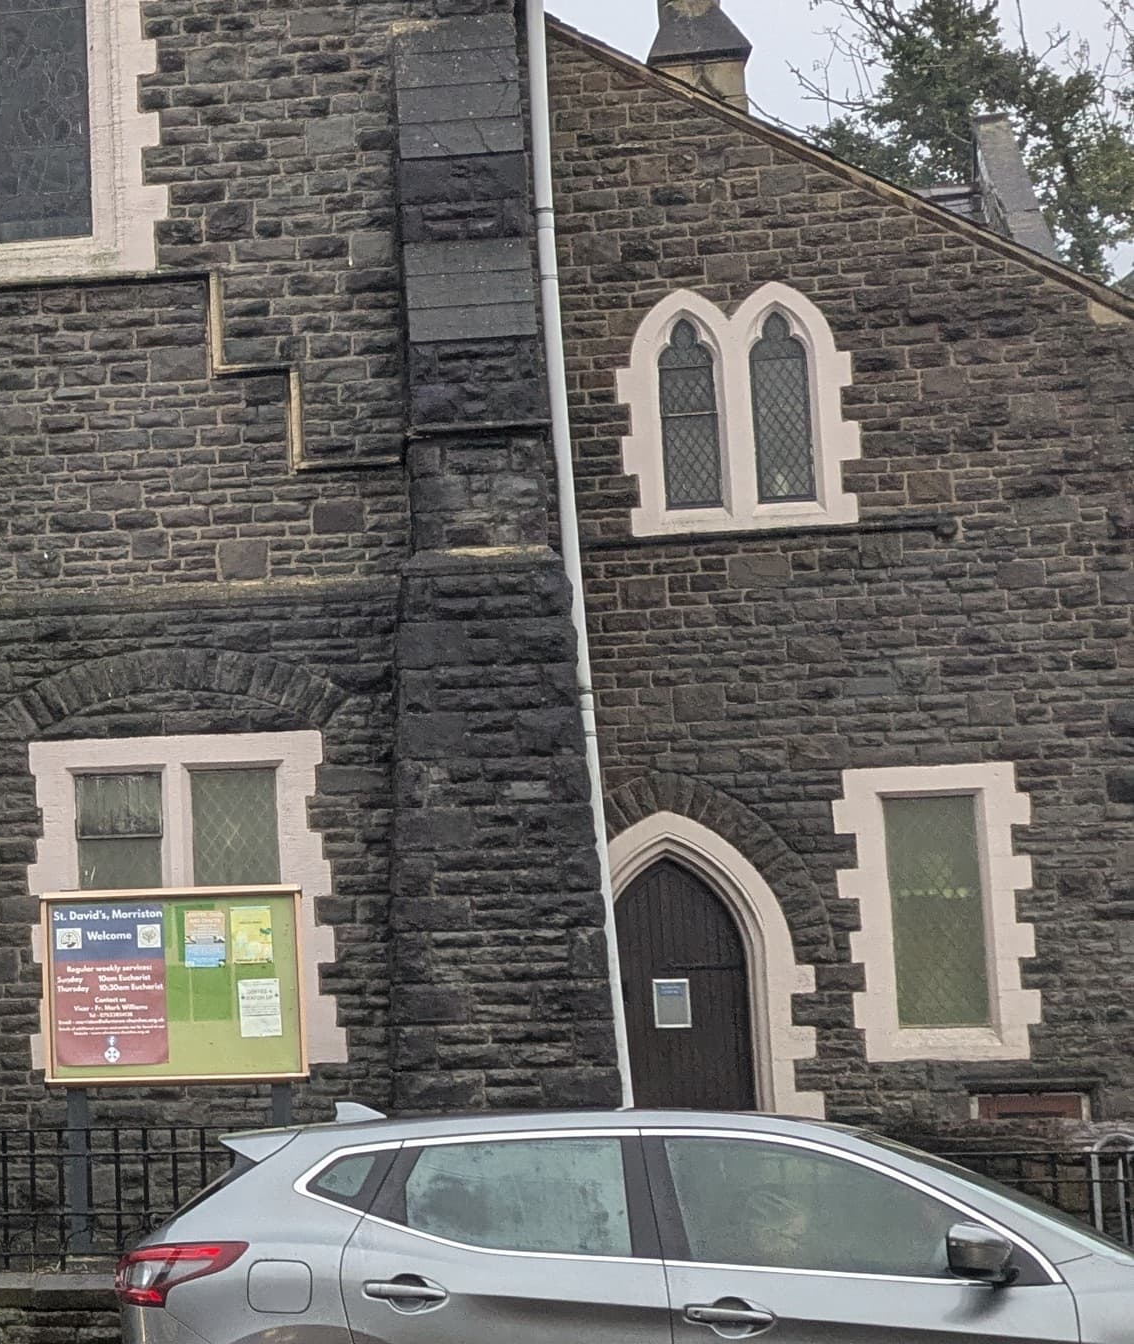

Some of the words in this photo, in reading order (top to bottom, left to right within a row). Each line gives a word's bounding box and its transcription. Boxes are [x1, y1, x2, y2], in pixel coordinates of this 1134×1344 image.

[53, 912, 67, 921] St.
[70, 910, 110, 921] David's,
[112, 909, 162, 919] Morriston
[87, 931, 132, 941] Welcome
[67, 965, 94, 973] Regular
[95, 964, 121, 973] weekly
[57, 976, 83, 984] Sunday
